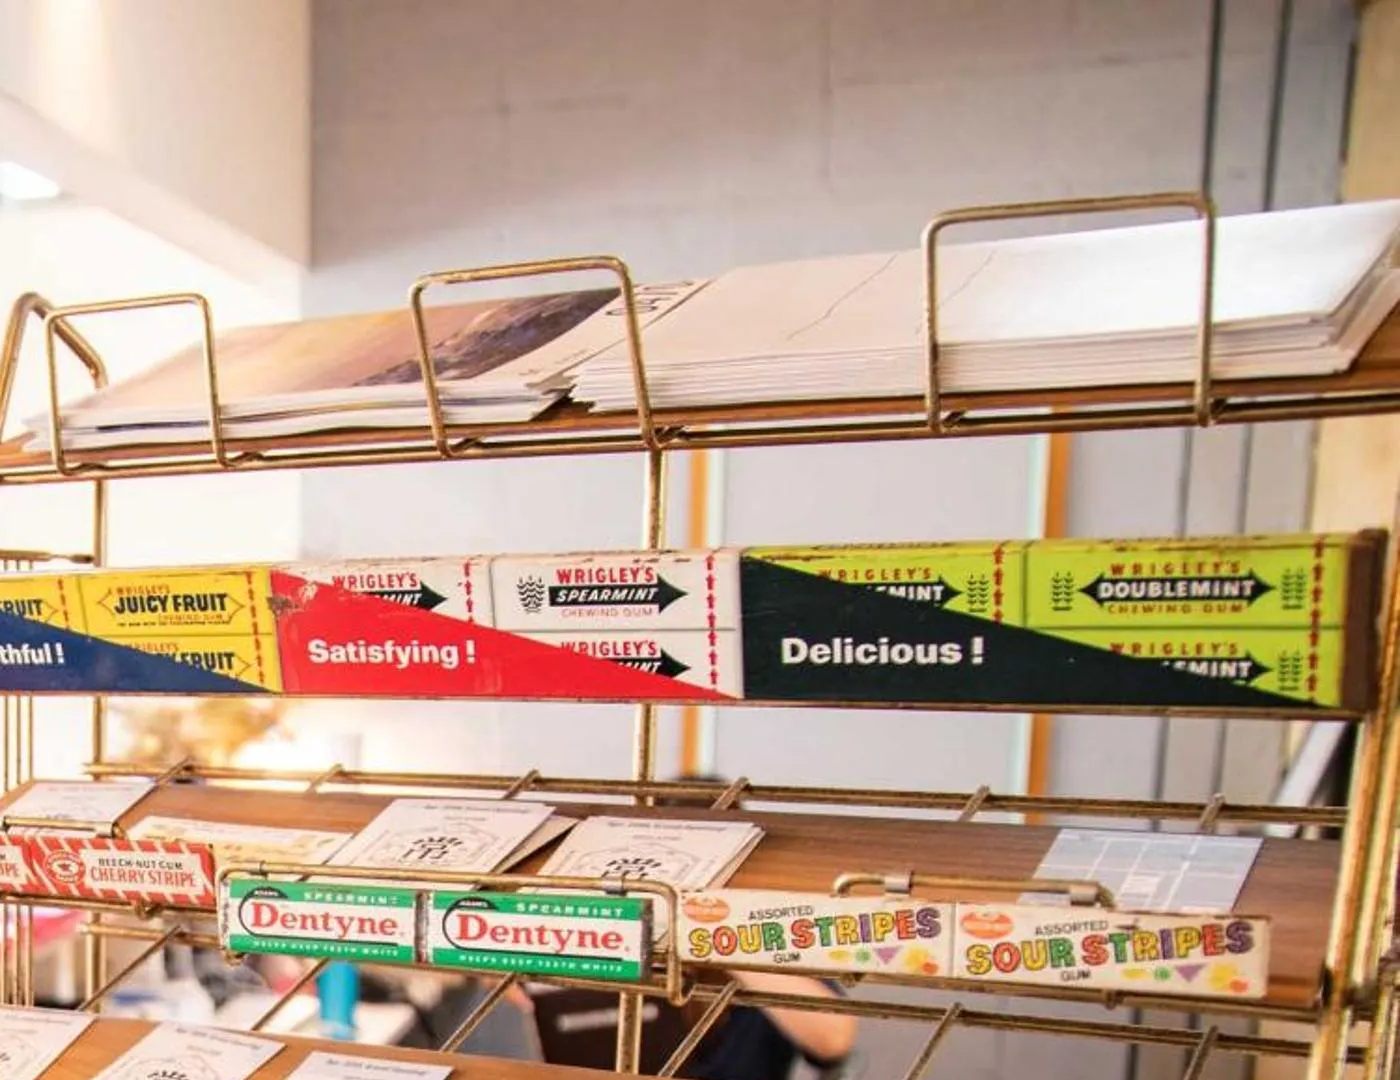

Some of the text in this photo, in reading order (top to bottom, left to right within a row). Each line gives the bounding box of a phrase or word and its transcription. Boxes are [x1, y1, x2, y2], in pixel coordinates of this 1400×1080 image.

[556, 566, 655, 583] WRIGLEY'S
[1110, 561, 1241, 576] WRIGLEY'S
[556, 588, 658, 602] SPEARMINT
[1099, 579, 1256, 599] DOUBLEMINT
[114, 593, 228, 614] JUICY FRUIT
[308, 639, 459, 669] Satisfying
[781, 637, 963, 664] Delicious
[90, 866, 197, 888] CHERRY STRIPE
[516, 903, 624, 917] SPEARMINT
[749, 905, 815, 921] ASSORTED
[252, 902, 399, 939] Dentyne
[1035, 920, 1110, 936] ASSORTED
[456, 914, 624, 954] Dentyne
[688, 907, 942, 958] SOUR STRIPES
[773, 952, 802, 964] GUM
[966, 920, 1255, 976] SOUR STRIPES
[1061, 970, 1092, 982] GUM
